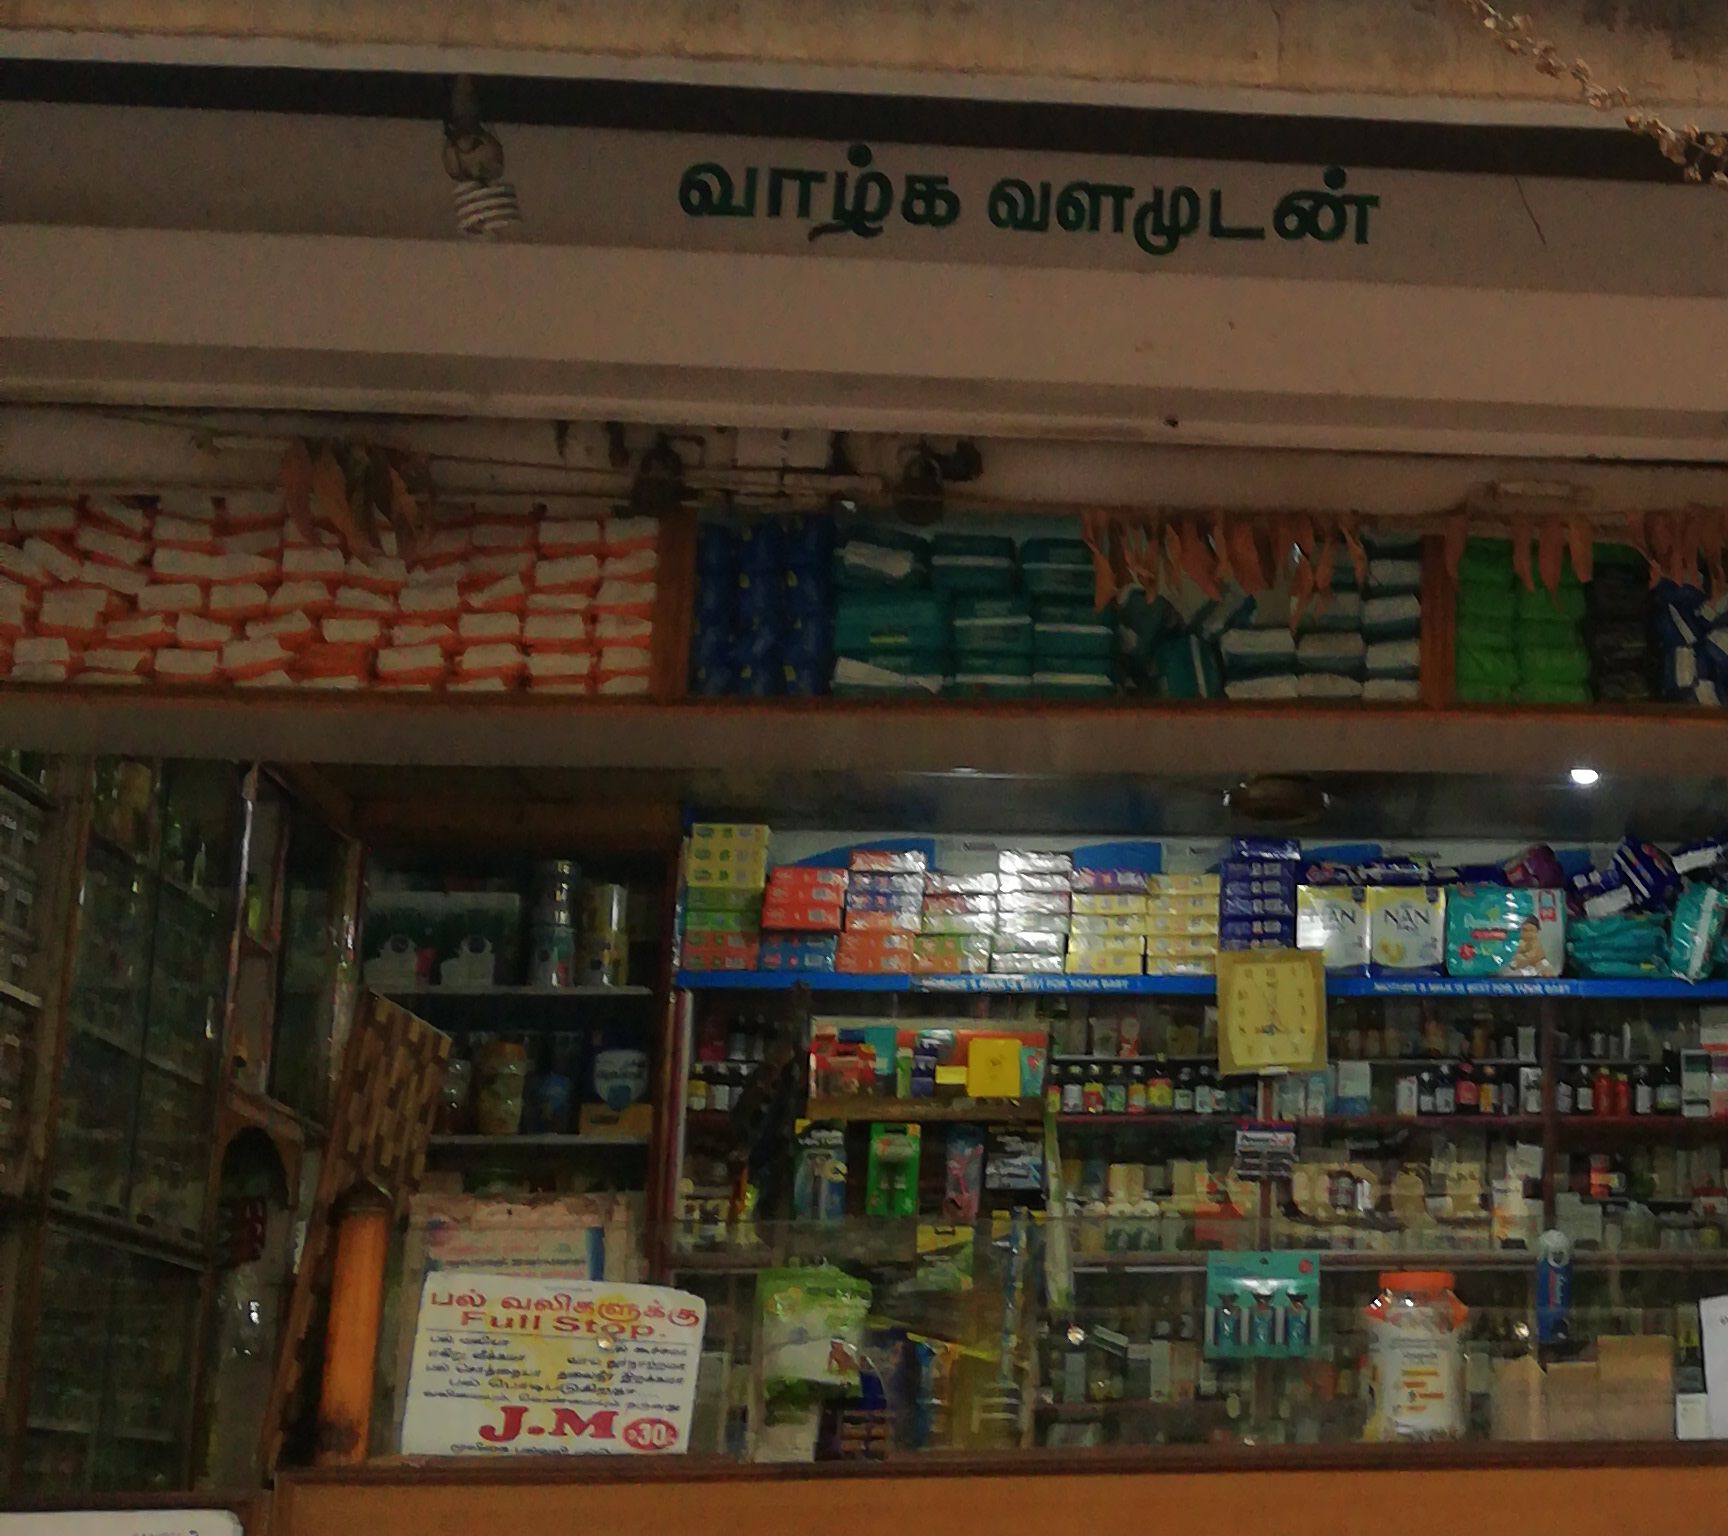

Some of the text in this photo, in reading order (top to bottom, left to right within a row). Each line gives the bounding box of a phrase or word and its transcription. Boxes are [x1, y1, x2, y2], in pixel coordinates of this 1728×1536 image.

[678, 143, 1381, 257] வாழ்க வளமுடன்
[430, 1287, 488, 1309] பல்
[460, 1310, 542, 1331] Full
[478, 1406, 620, 1443] J.M
